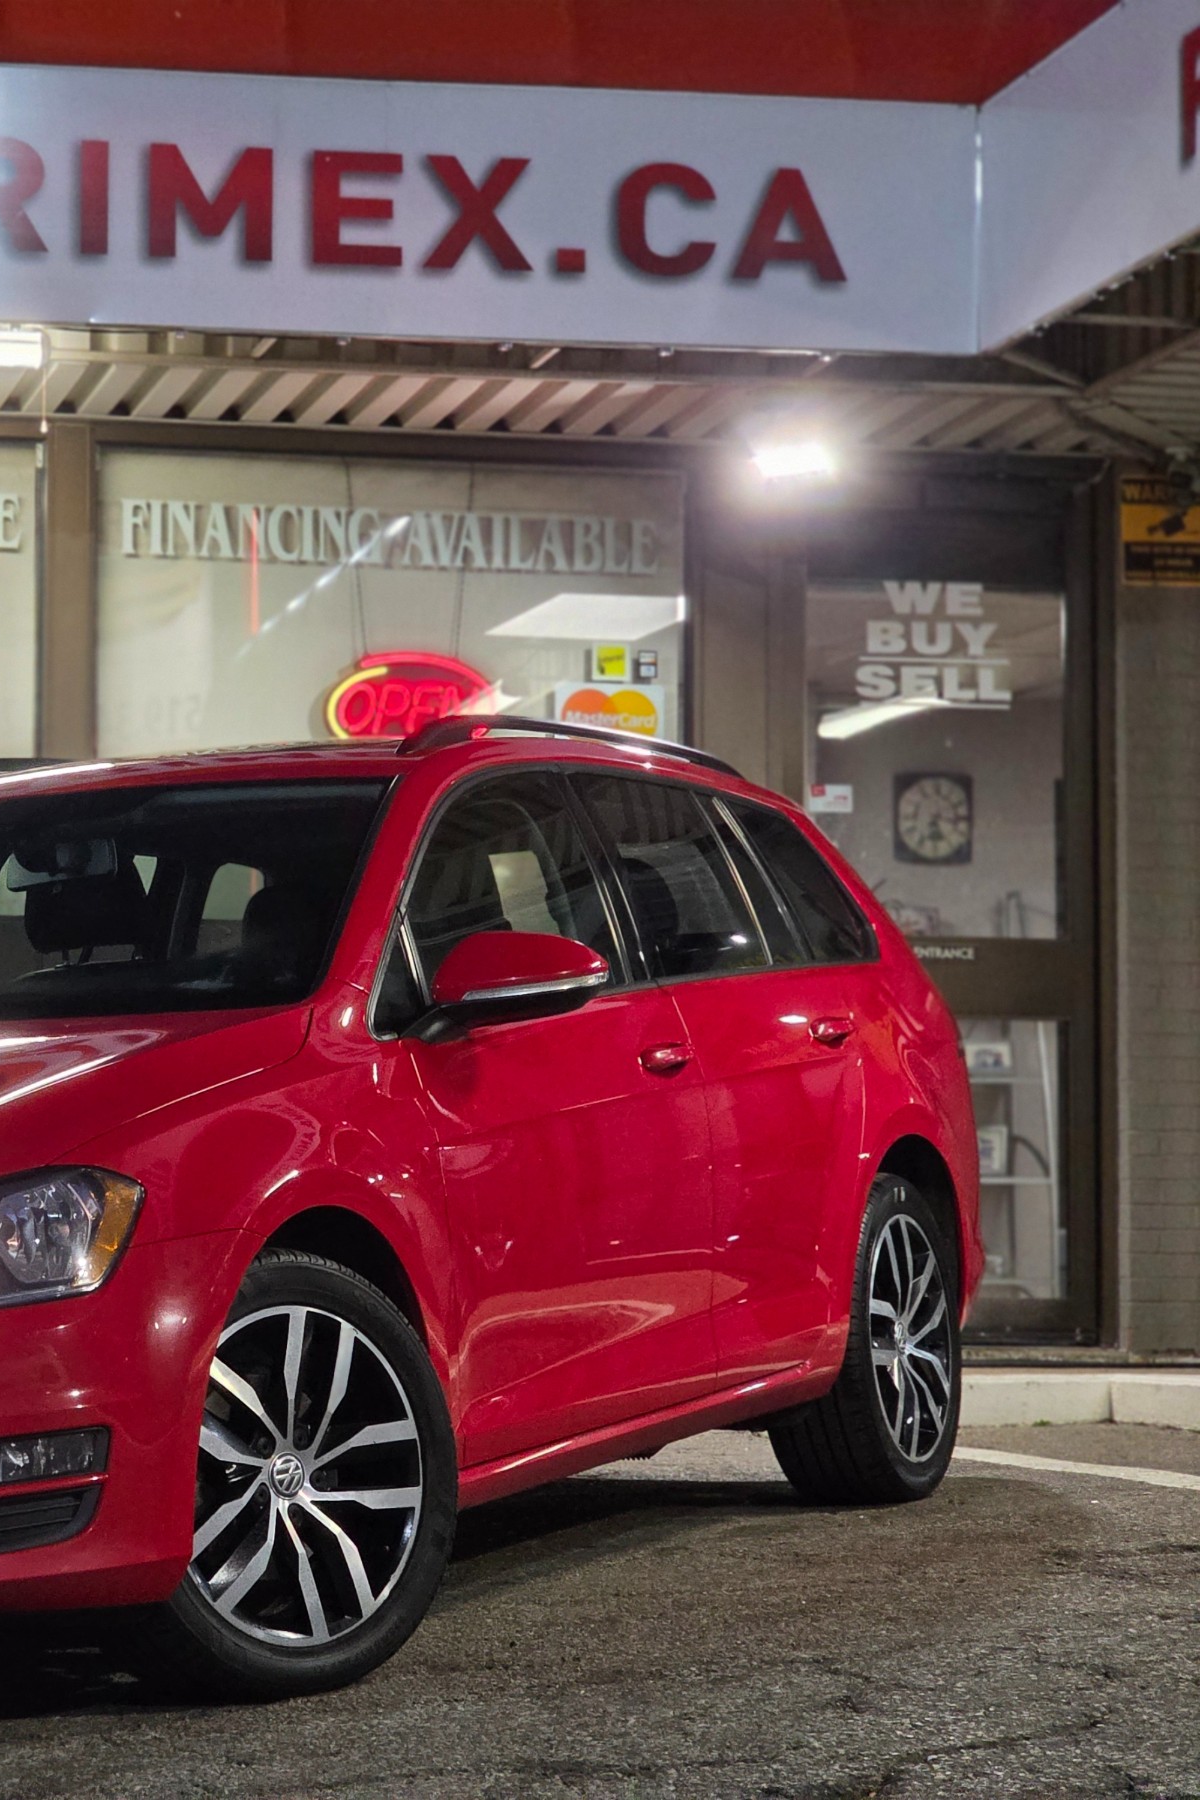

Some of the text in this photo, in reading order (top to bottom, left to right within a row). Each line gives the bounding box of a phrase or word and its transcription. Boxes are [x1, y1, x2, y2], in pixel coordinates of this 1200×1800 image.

[120, 498, 660, 576] FINANCING AVAILABLE
[883, 581, 984, 616] WE
[866, 620, 998, 657] BUY
[855, 664, 1013, 702] SELL
[565, 710, 655, 729] MasterCard
[913, 945, 975, 961] ENTRANCE
